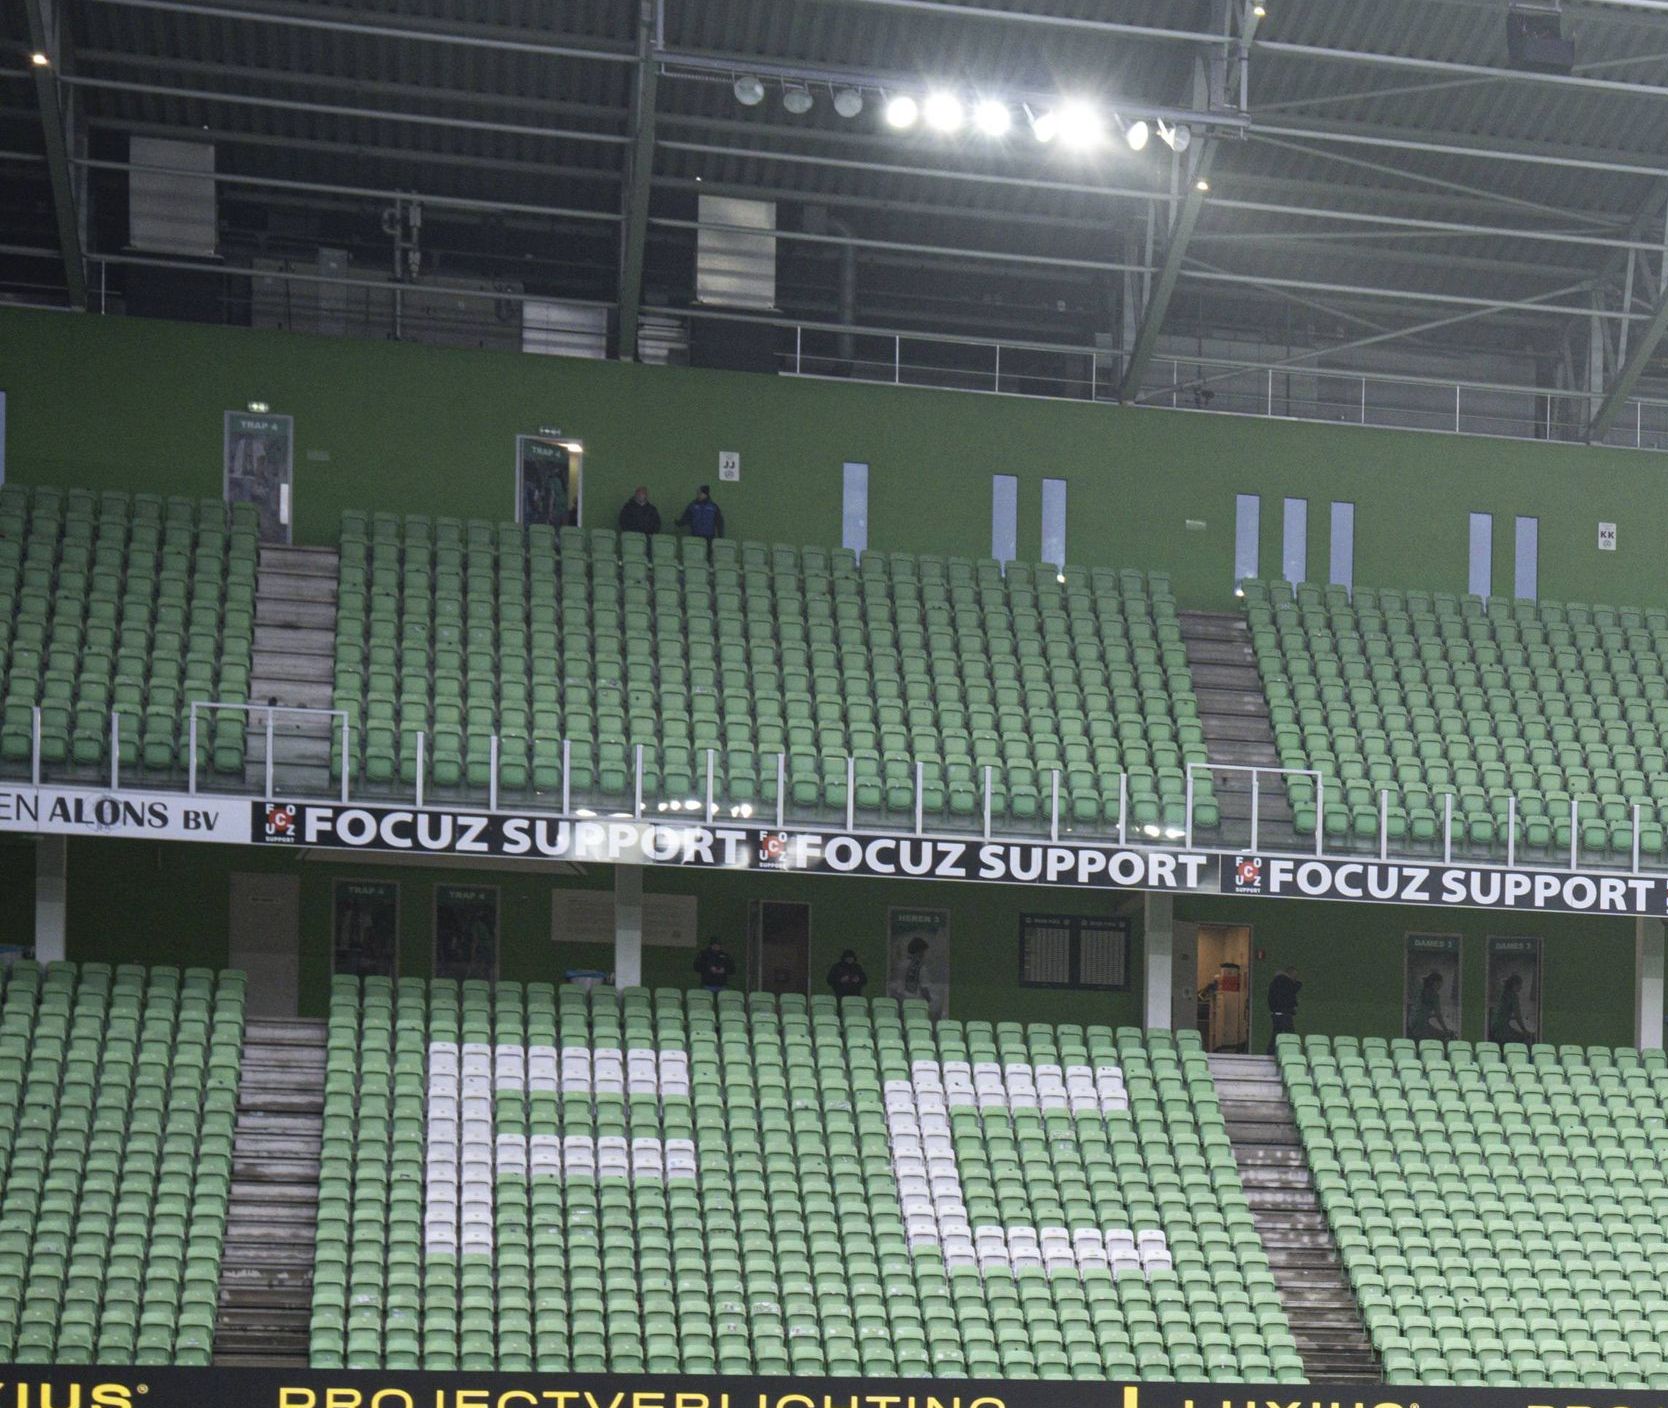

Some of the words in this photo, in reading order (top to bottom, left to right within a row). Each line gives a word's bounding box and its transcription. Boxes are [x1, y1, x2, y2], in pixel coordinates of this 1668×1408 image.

[1600, 530, 1614, 539] KK
[49, 796, 169, 829] ALONS
[183, 809, 220, 831] BV
[304, 807, 489, 853] FOCUZ
[502, 818, 747, 865] SUPPORT
[795, 834, 967, 877] FOCUZ
[978, 845, 1207, 888] SUPPORT
[1269, 860, 1430, 901] FOCUZ
[1441, 870, 1655, 911] SUPPORT
[426, 1041, 1174, 1286] FC
